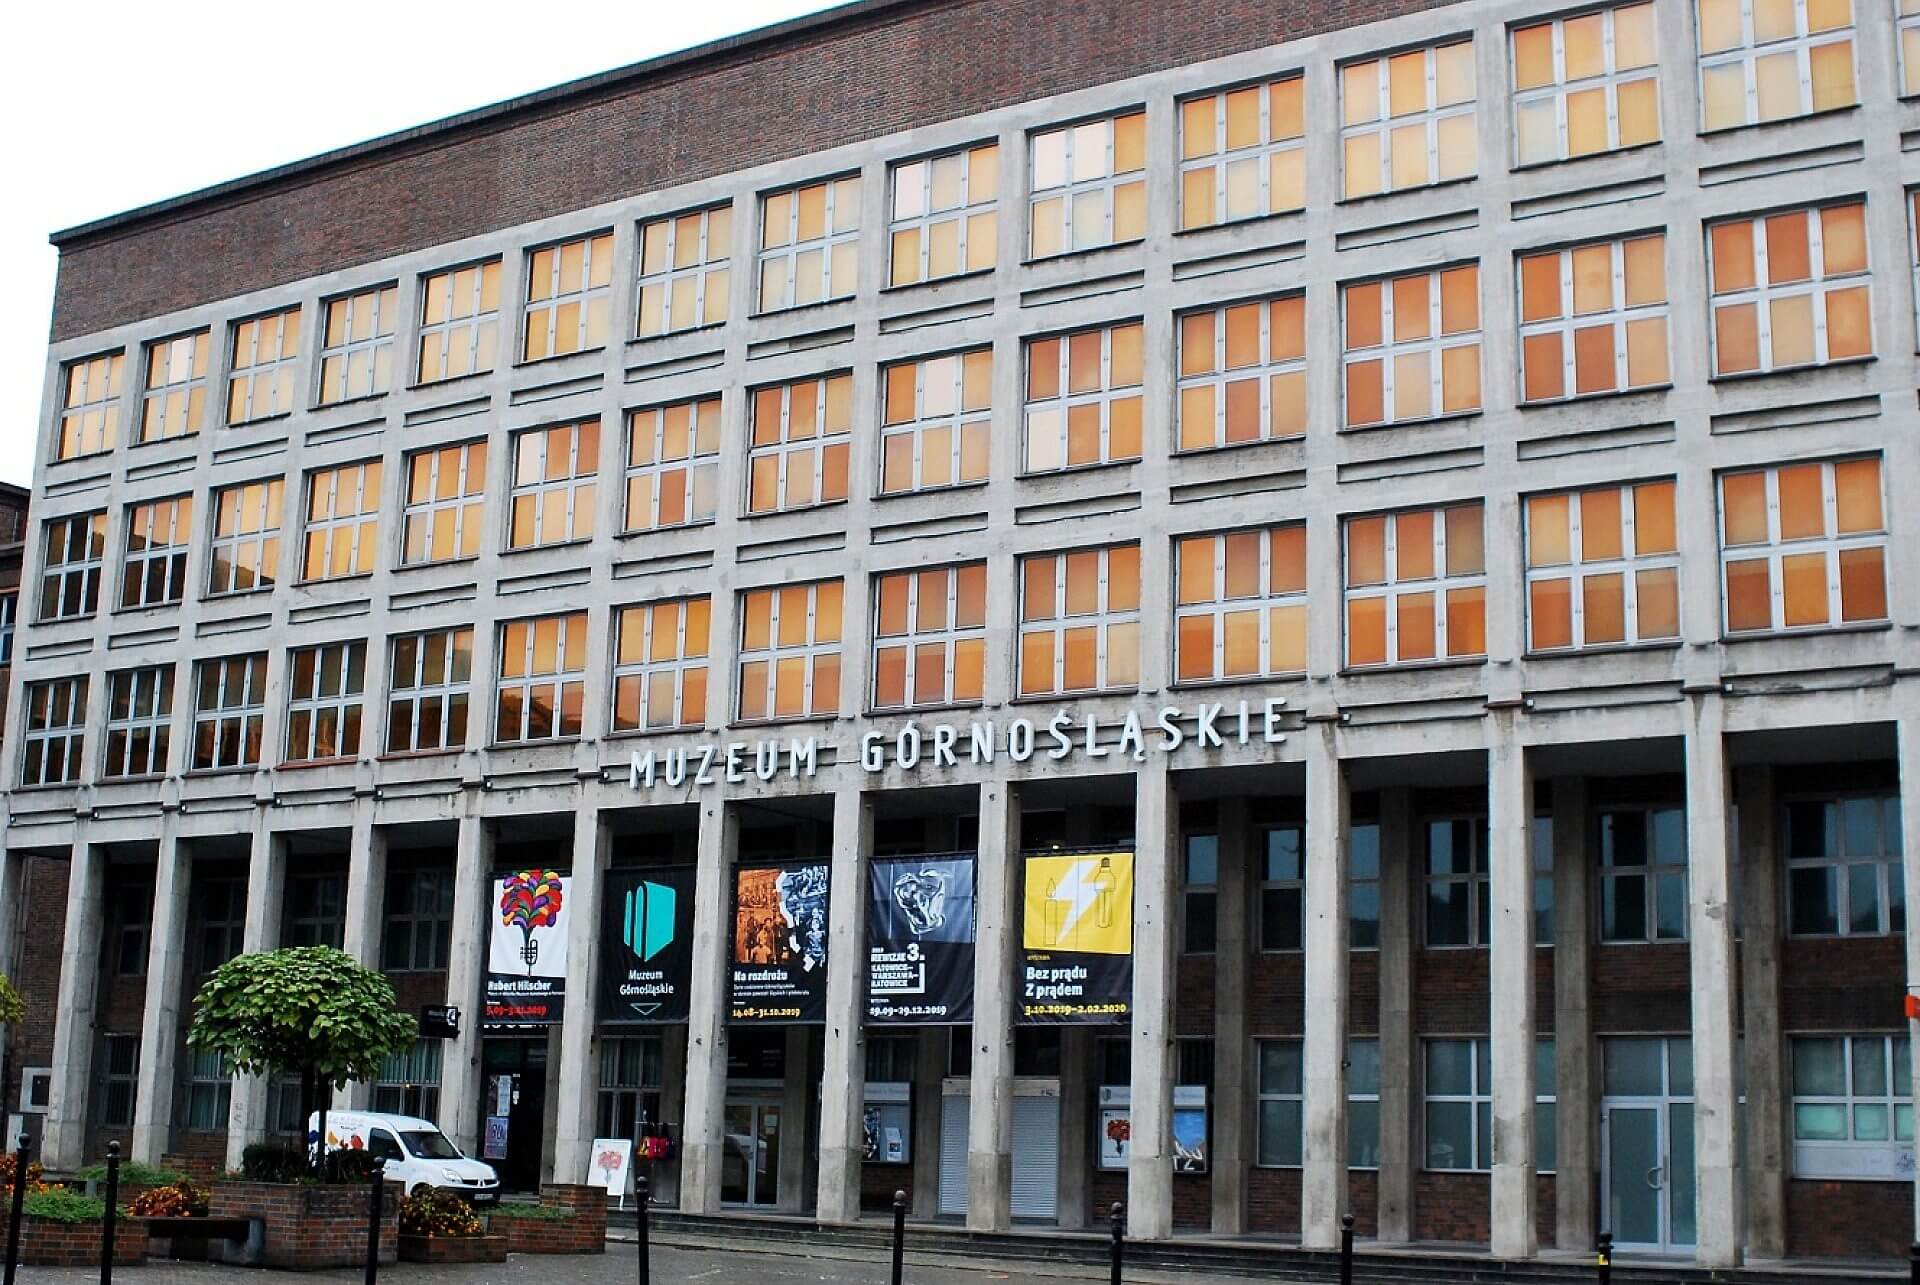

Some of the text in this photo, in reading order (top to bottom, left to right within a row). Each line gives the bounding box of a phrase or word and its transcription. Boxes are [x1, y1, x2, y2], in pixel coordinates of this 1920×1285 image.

[629, 697, 1287, 789] MUZEUM GÓRNOŚLĄSKIE
[628, 969, 663, 980] Muzeum
[1026, 965, 1087, 982] Bez prądu
[1036, 982, 1083, 999] prądem
